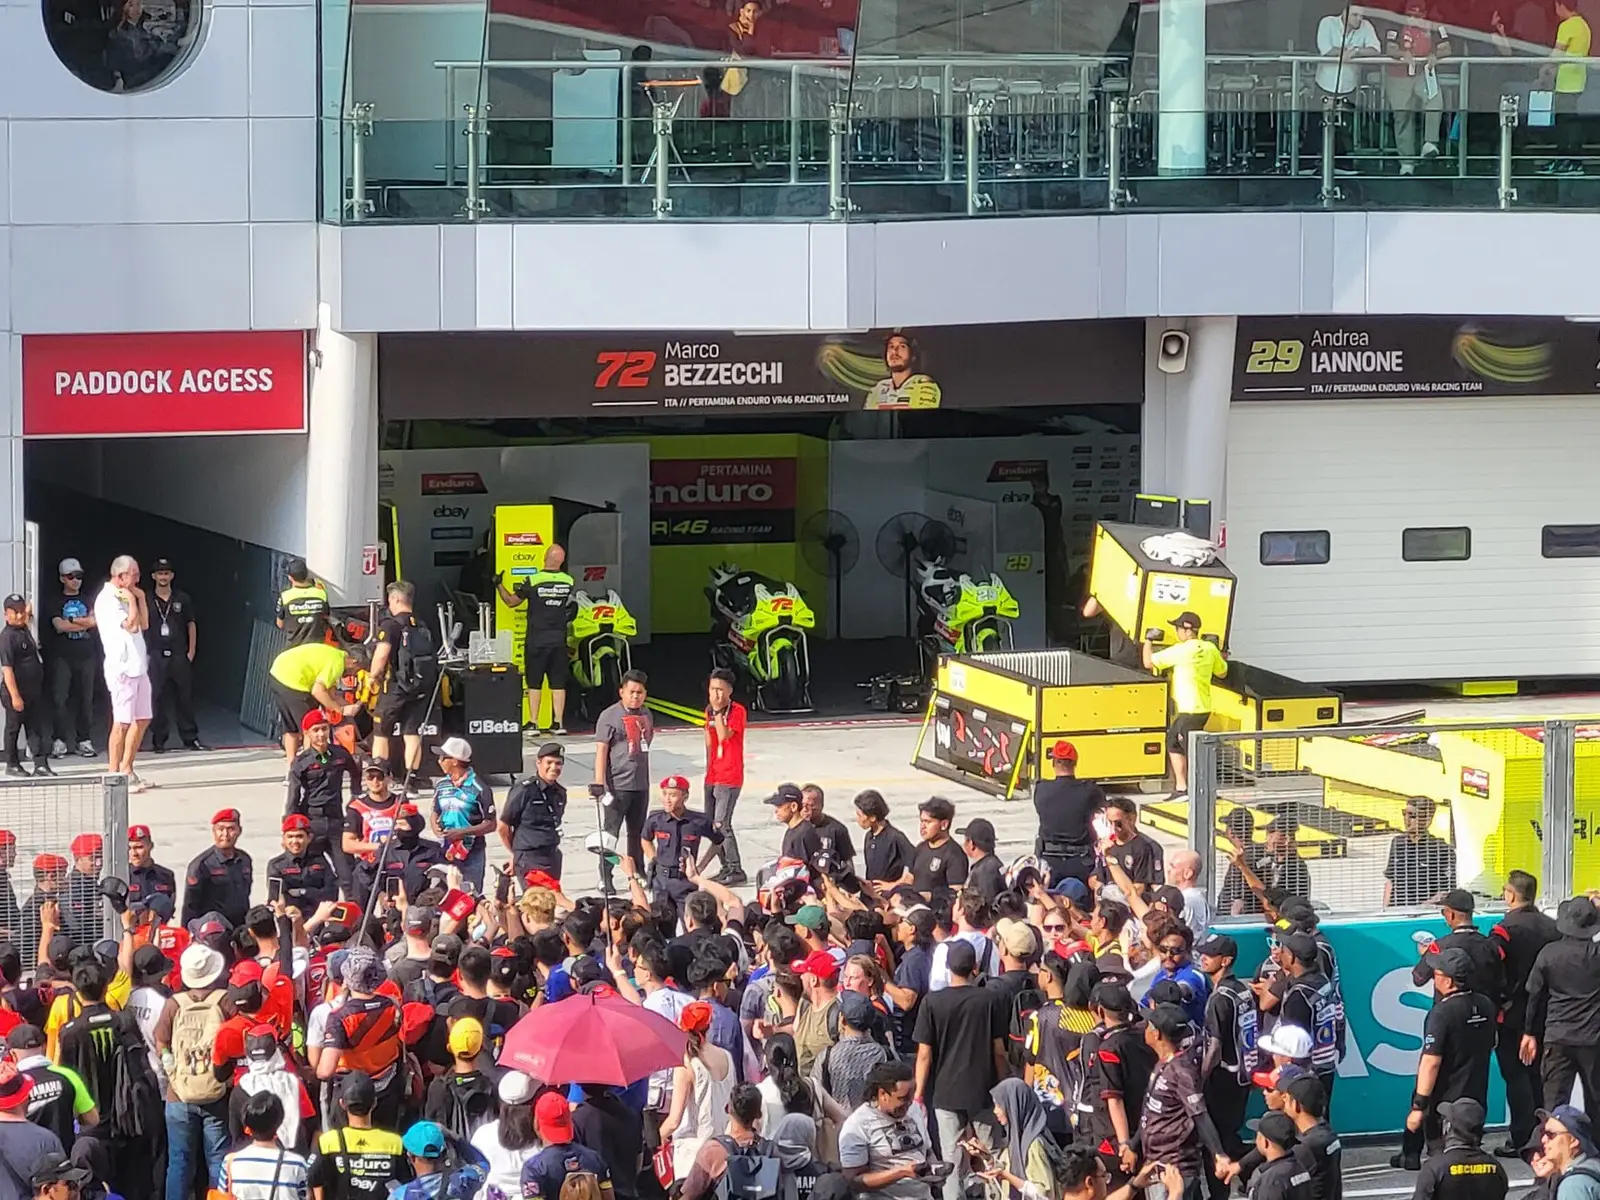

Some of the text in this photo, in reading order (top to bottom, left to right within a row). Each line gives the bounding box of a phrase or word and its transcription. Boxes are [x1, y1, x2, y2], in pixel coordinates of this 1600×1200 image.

[1311, 329, 1369, 347] Andrea
[664, 342, 720, 359] Marco
[1246, 340, 1304, 373] 29
[1311, 350, 1404, 373] IANNONE
[595, 351, 657, 388] 72
[664, 362, 783, 387] BEZZECCHI
[55, 368, 273, 395] PADDOCK ACCESS
[1311, 384, 1324, 394] ITA
[1333, 384, 1377, 393] PERTAMINA
[1378, 384, 1409, 392] ENDURO
[1410, 383, 1431, 392] VR46
[1432, 383, 1460, 392] RACING
[1461, 382, 1483, 391] TEAM
[664, 398, 678, 407] ITA
[688, 397, 735, 407] PERTAMINA
[737, 396, 770, 405] ENDURO
[772, 395, 793, 404] VR46
[794, 395, 825, 404] RACING
[826, 394, 849, 403] TEAM
[700, 464, 773, 476] PERTAMINA
[429, 479, 475, 489] Enduro
[433, 505, 470, 519] ebay
[513, 552, 536, 562] ebay
[1005, 555, 1033, 572] 29
[584, 566, 608, 582] 72
[592, 605, 616, 620] 72
[770, 598, 793, 612] 72
[483, 719, 520, 734] Beta
[30, 1080, 63, 1098] AMAHA
[1449, 1164, 1498, 1175] SECURITY
